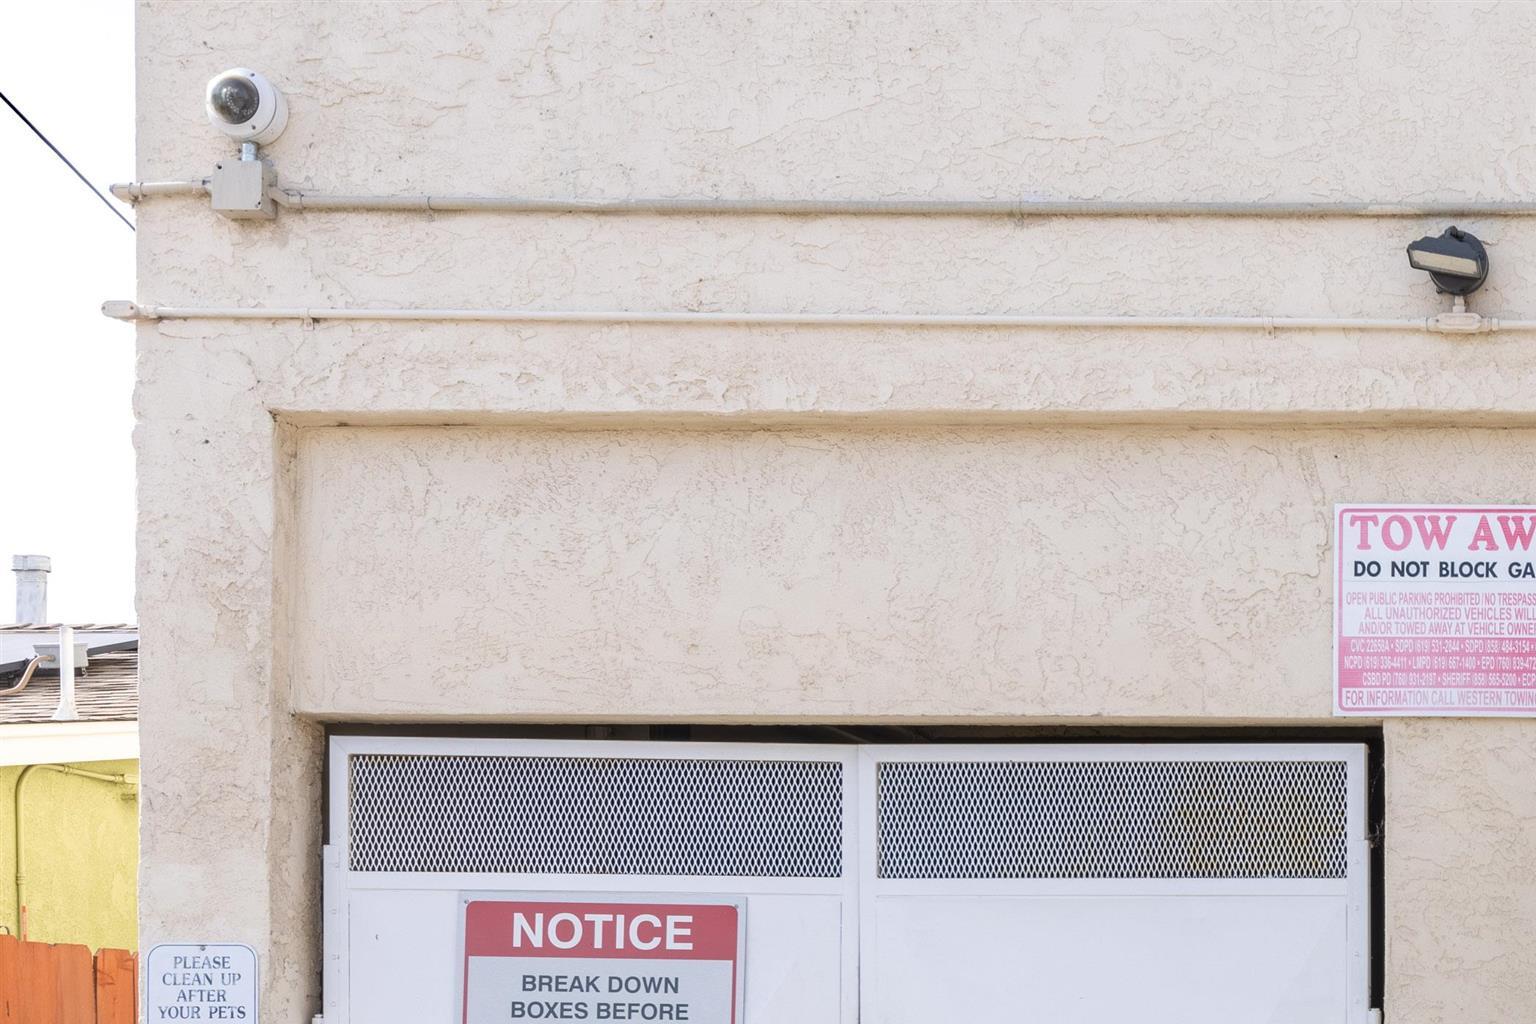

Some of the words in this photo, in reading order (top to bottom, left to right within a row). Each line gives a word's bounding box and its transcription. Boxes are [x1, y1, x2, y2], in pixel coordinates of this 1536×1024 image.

[1350, 514, 1457, 551] TOW
[1353, 560, 1381, 578] DO
[1391, 560, 1430, 578] NOT
[1438, 561, 1498, 579] BLOCK
[1346, 592, 1367, 605] OPEN
[1369, 592, 1397, 606] PUBLIC
[1399, 592, 1432, 606] PARKING
[1434, 592, 1480, 606] PROHIBITED
[1364, 607, 1383, 620] ALL
[1385, 607, 1462, 620] UNAUTHORIZED
[1464, 607, 1512, 620] VEHICLES
[1358, 622, 1392, 635] AND/OR
[1395, 622, 1426, 635] TOWED
[1428, 622, 1453, 635] AWAY
[1454, 622, 1466, 635] AT
[1467, 622, 1505, 635] VEHICLE
[1395, 639, 1414, 653] SDPD
[1465, 639, 1484, 653] SDPD
[1481, 656, 1495, 670] EPD
[1442, 673, 1470, 686] SHERIFF
[1345, 690, 1364, 706] FOR
[1367, 691, 1429, 706] INFORMATION
[1431, 691, 1455, 706] CALL
[1457, 691, 1502, 706] WESTERN
[512, 912, 693, 951] NOTICE
[173, 956, 231, 969] PLEASE
[162, 972, 213, 986] CLEAN
[221, 972, 242, 986] UP
[521, 975, 600, 993] BREAK
[607, 976, 679, 994] DOWN
[176, 989, 227, 1002] AFTER
[158, 1006, 200, 1019] YOUR
[209, 1006, 246, 1019] PETS
[510, 1001, 588, 1020] BOXES
[596, 1002, 689, 1021] BEFORE
